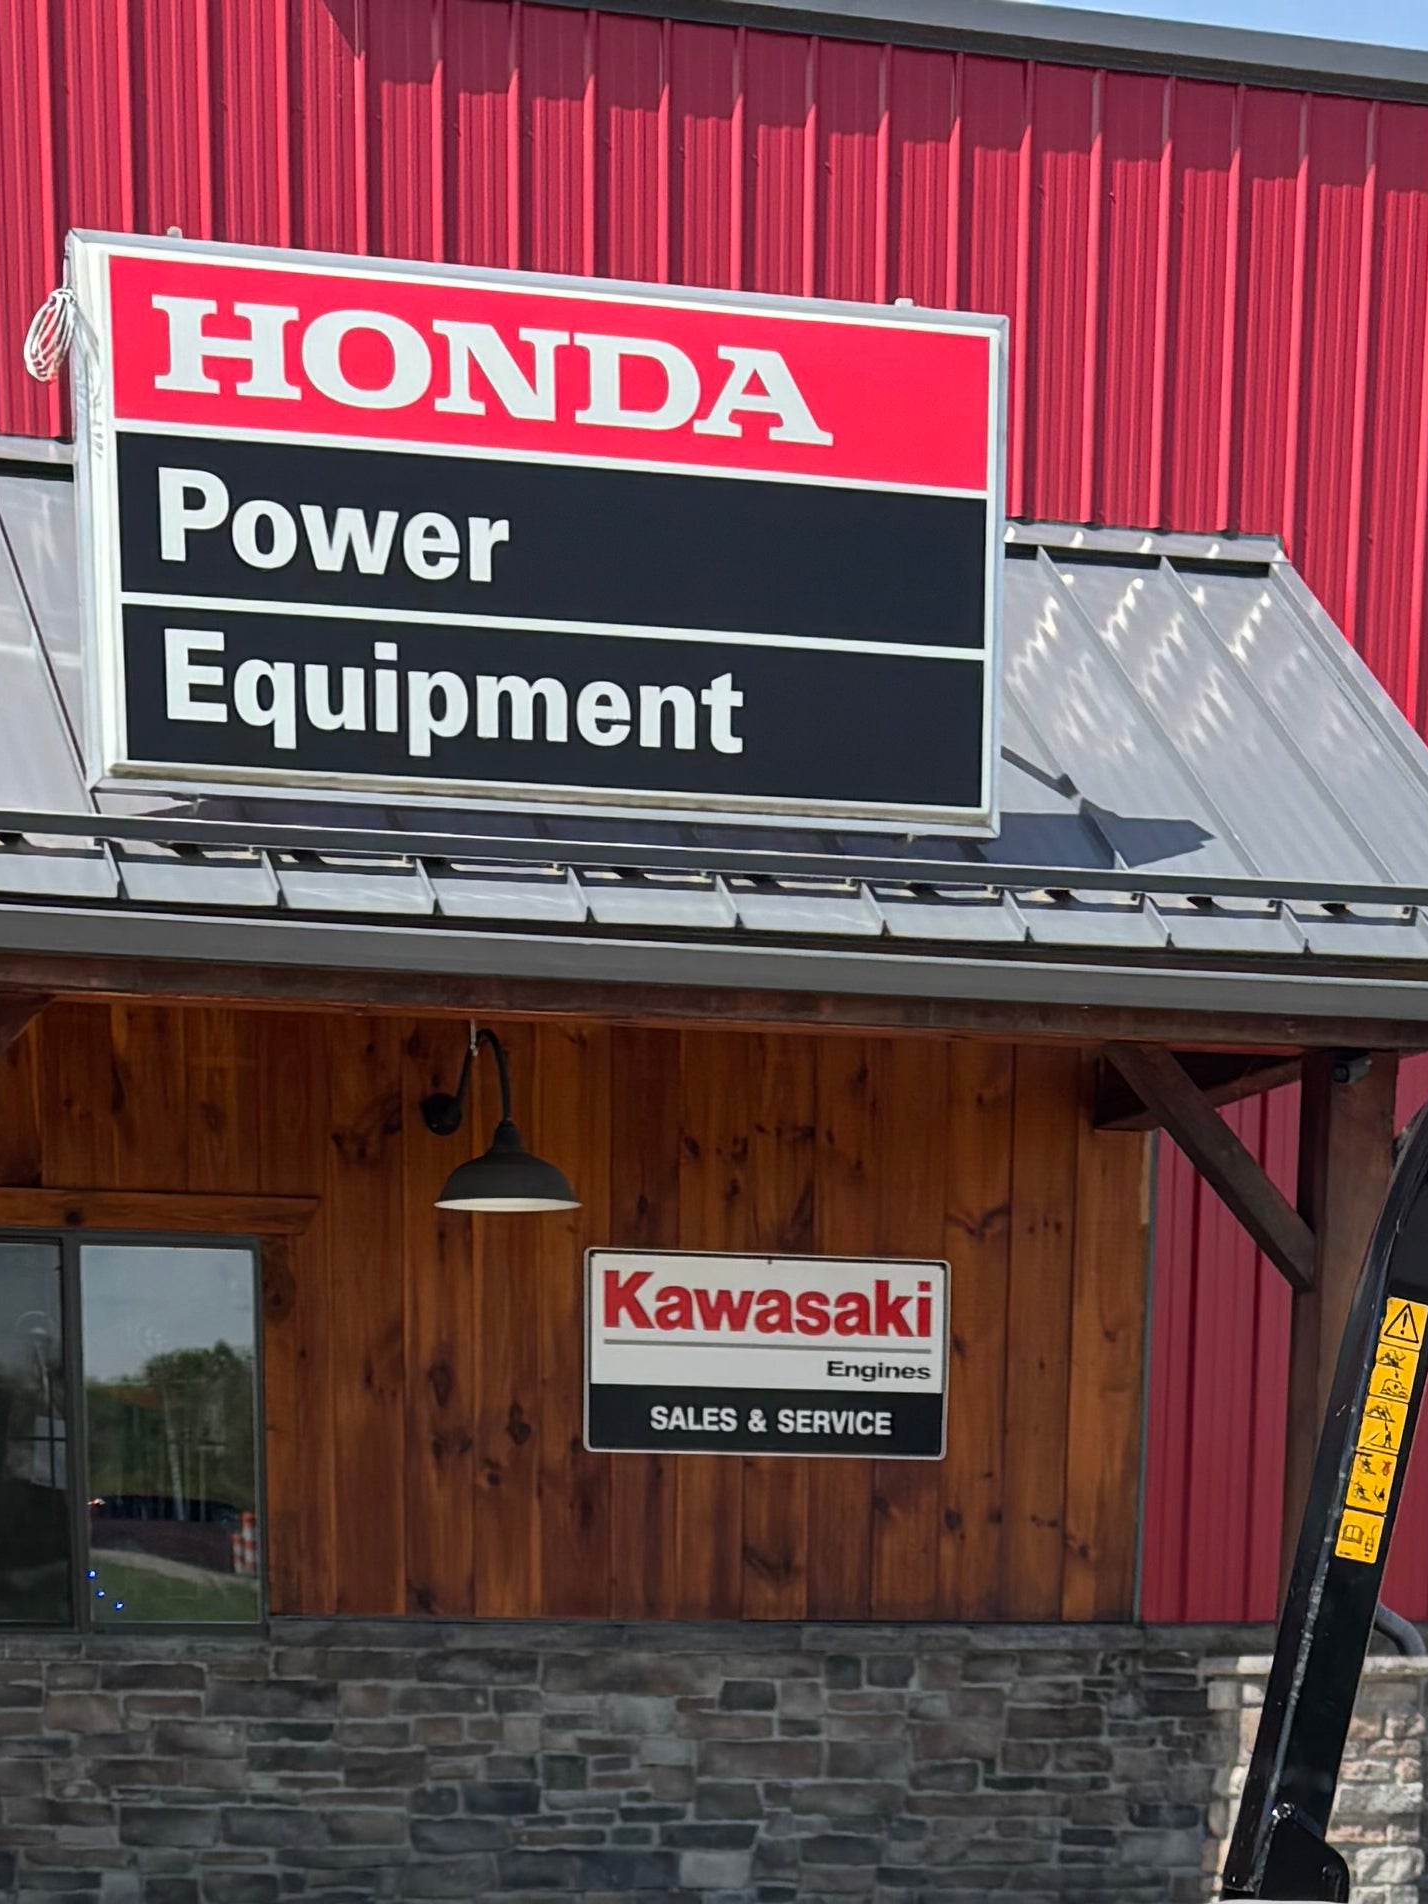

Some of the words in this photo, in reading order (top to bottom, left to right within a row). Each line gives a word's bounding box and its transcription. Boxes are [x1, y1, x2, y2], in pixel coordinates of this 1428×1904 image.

[151, 292, 834, 447] HONDA
[158, 466, 510, 583] Power
[164, 627, 744, 758] Equipment
[603, 1269, 932, 1338] Kawasaki
[827, 1360, 931, 1382] Engines
[650, 1406, 738, 1432] SALES
[747, 1408, 767, 1432] &
[778, 1410, 893, 1435] SERVICE
